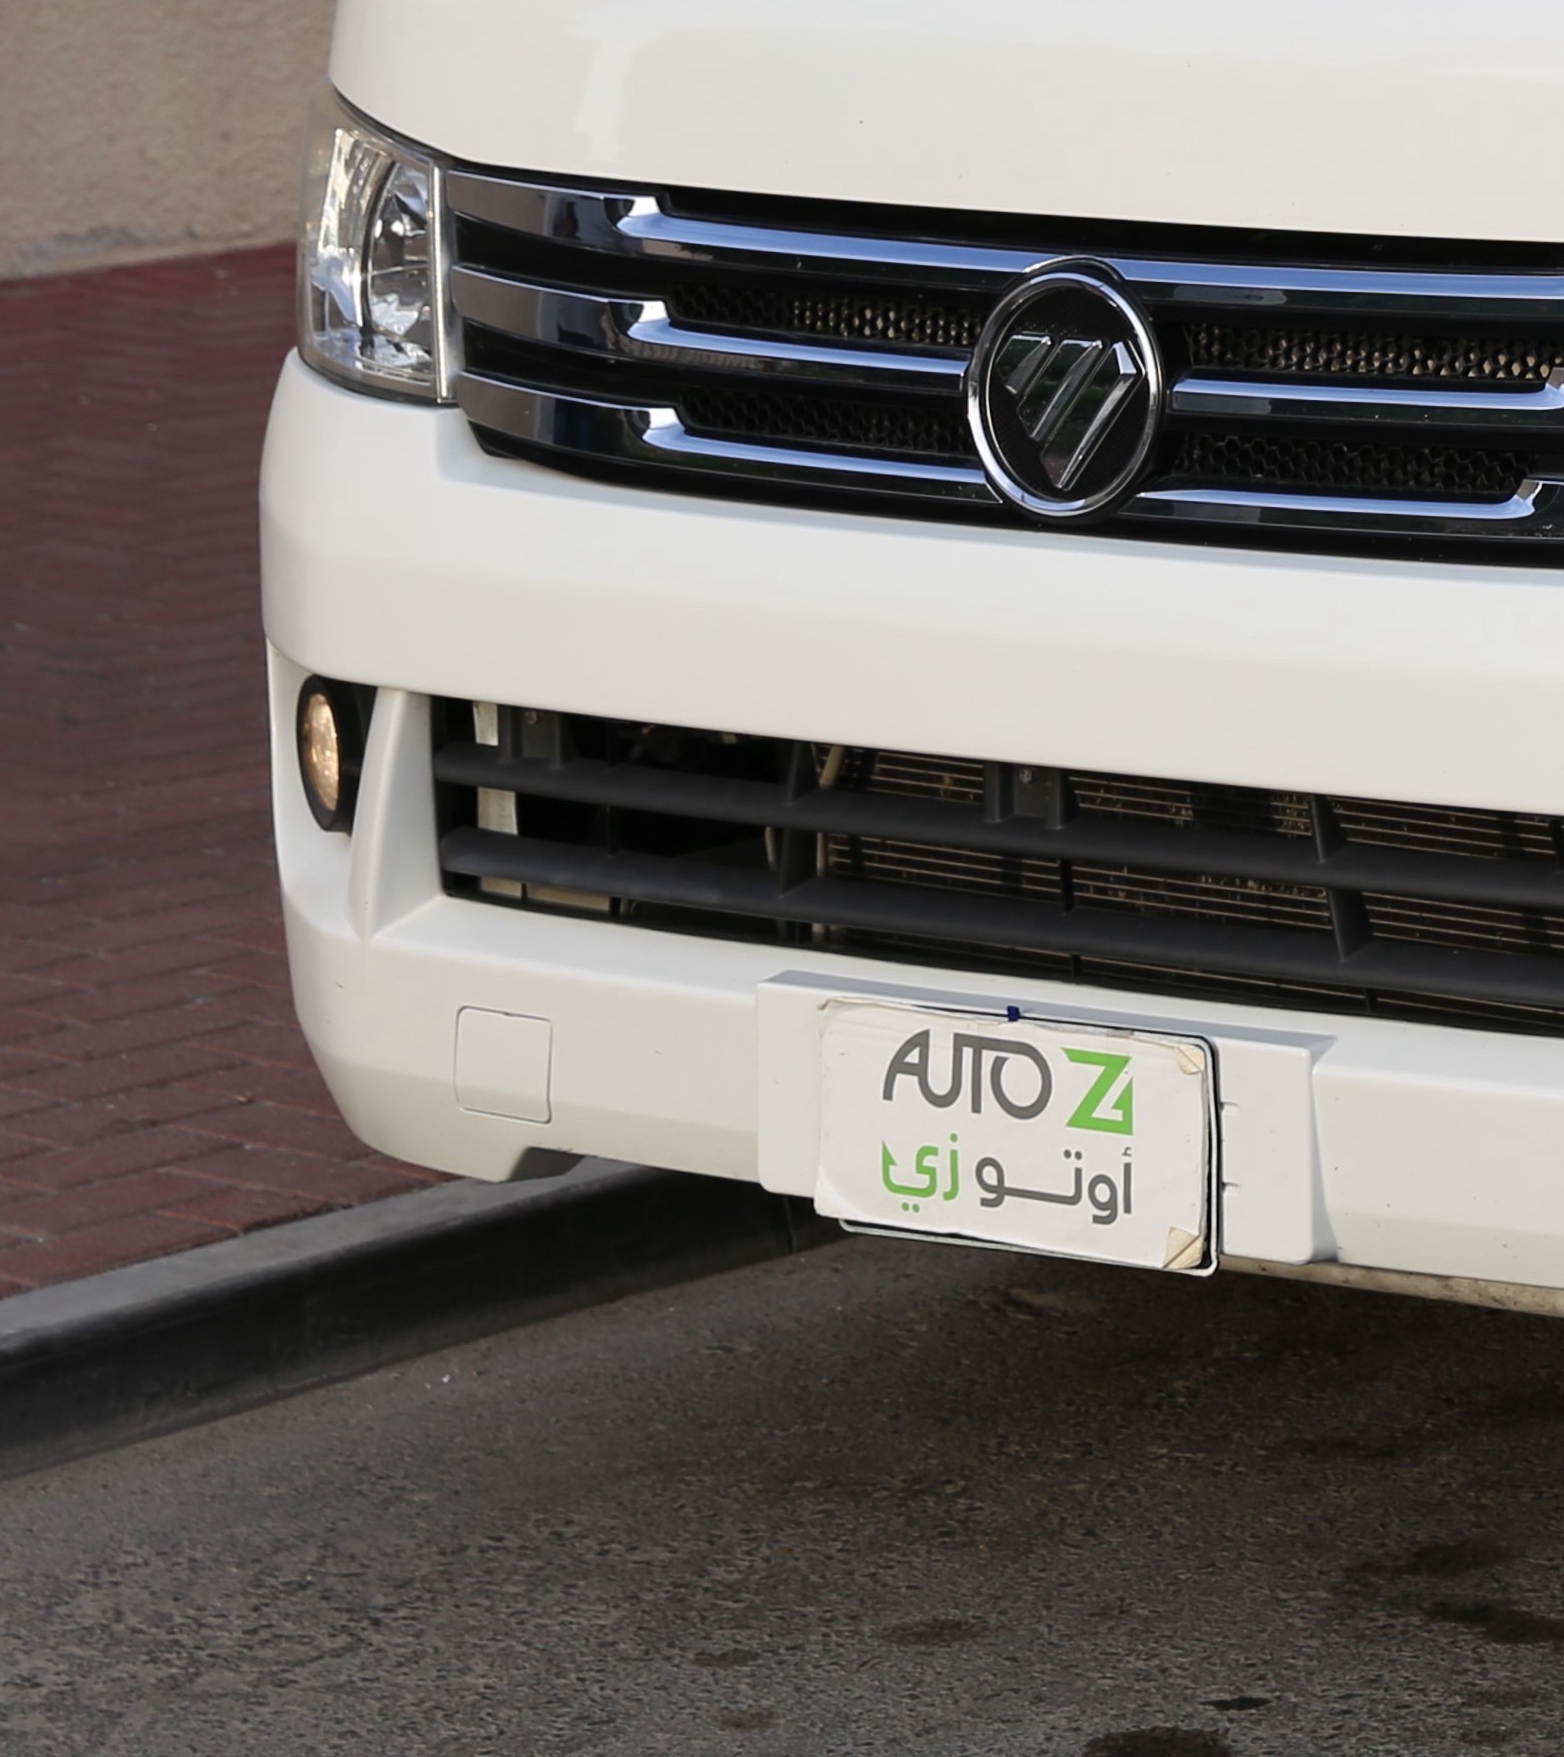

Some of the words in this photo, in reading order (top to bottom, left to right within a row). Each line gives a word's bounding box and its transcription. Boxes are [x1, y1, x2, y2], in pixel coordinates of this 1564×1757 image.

[882, 1028, 1053, 1121] AUTO
[1061, 1047, 1134, 1136] Z
[880, 1132, 960, 1214] زي
